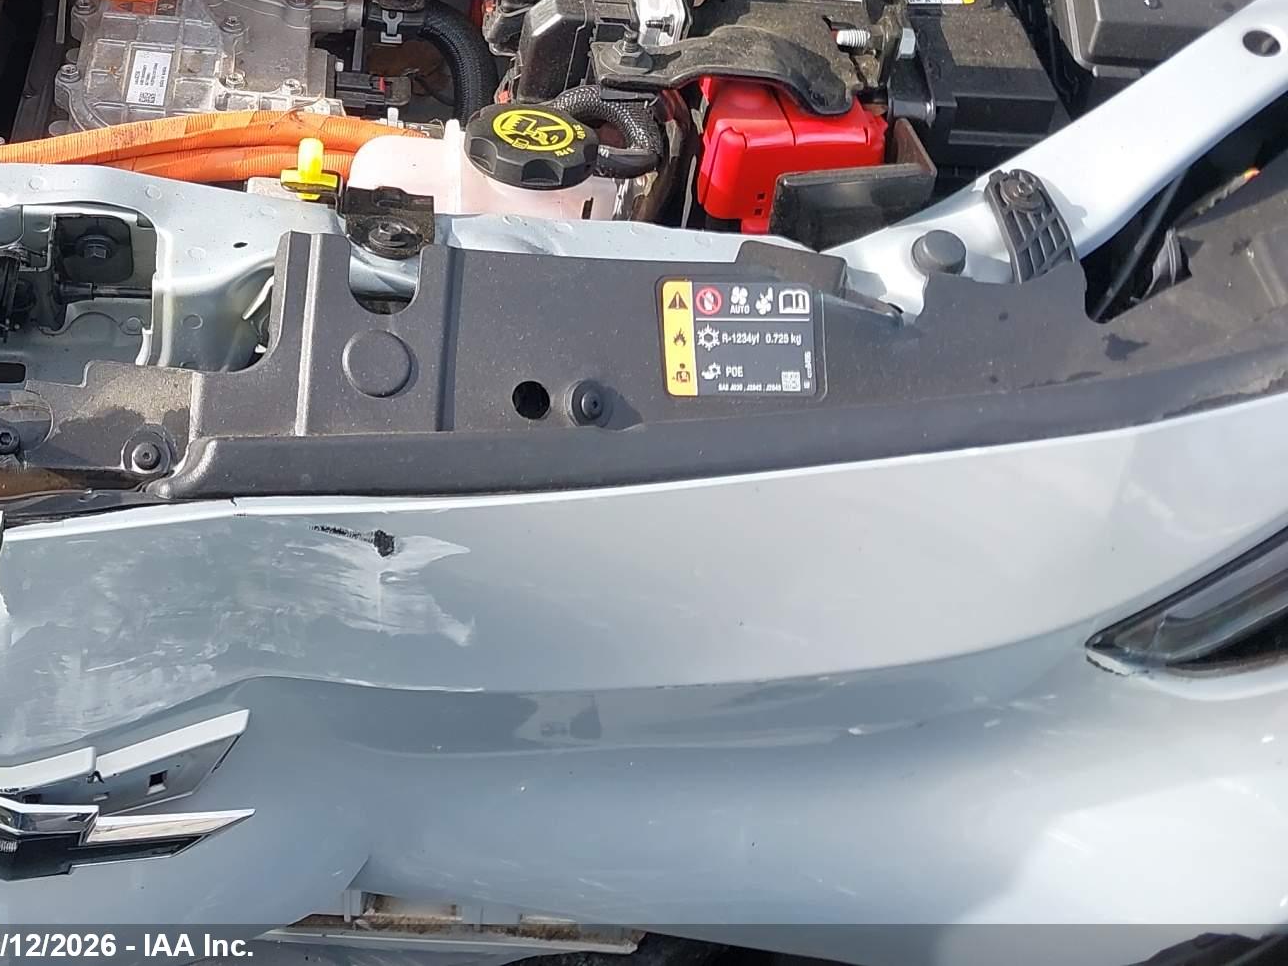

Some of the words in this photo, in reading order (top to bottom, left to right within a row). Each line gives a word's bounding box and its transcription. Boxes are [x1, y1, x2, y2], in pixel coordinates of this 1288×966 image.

[730, 305, 750, 314] AUTO
[790, 333, 802, 346] kg
[726, 366, 744, 378] POE
